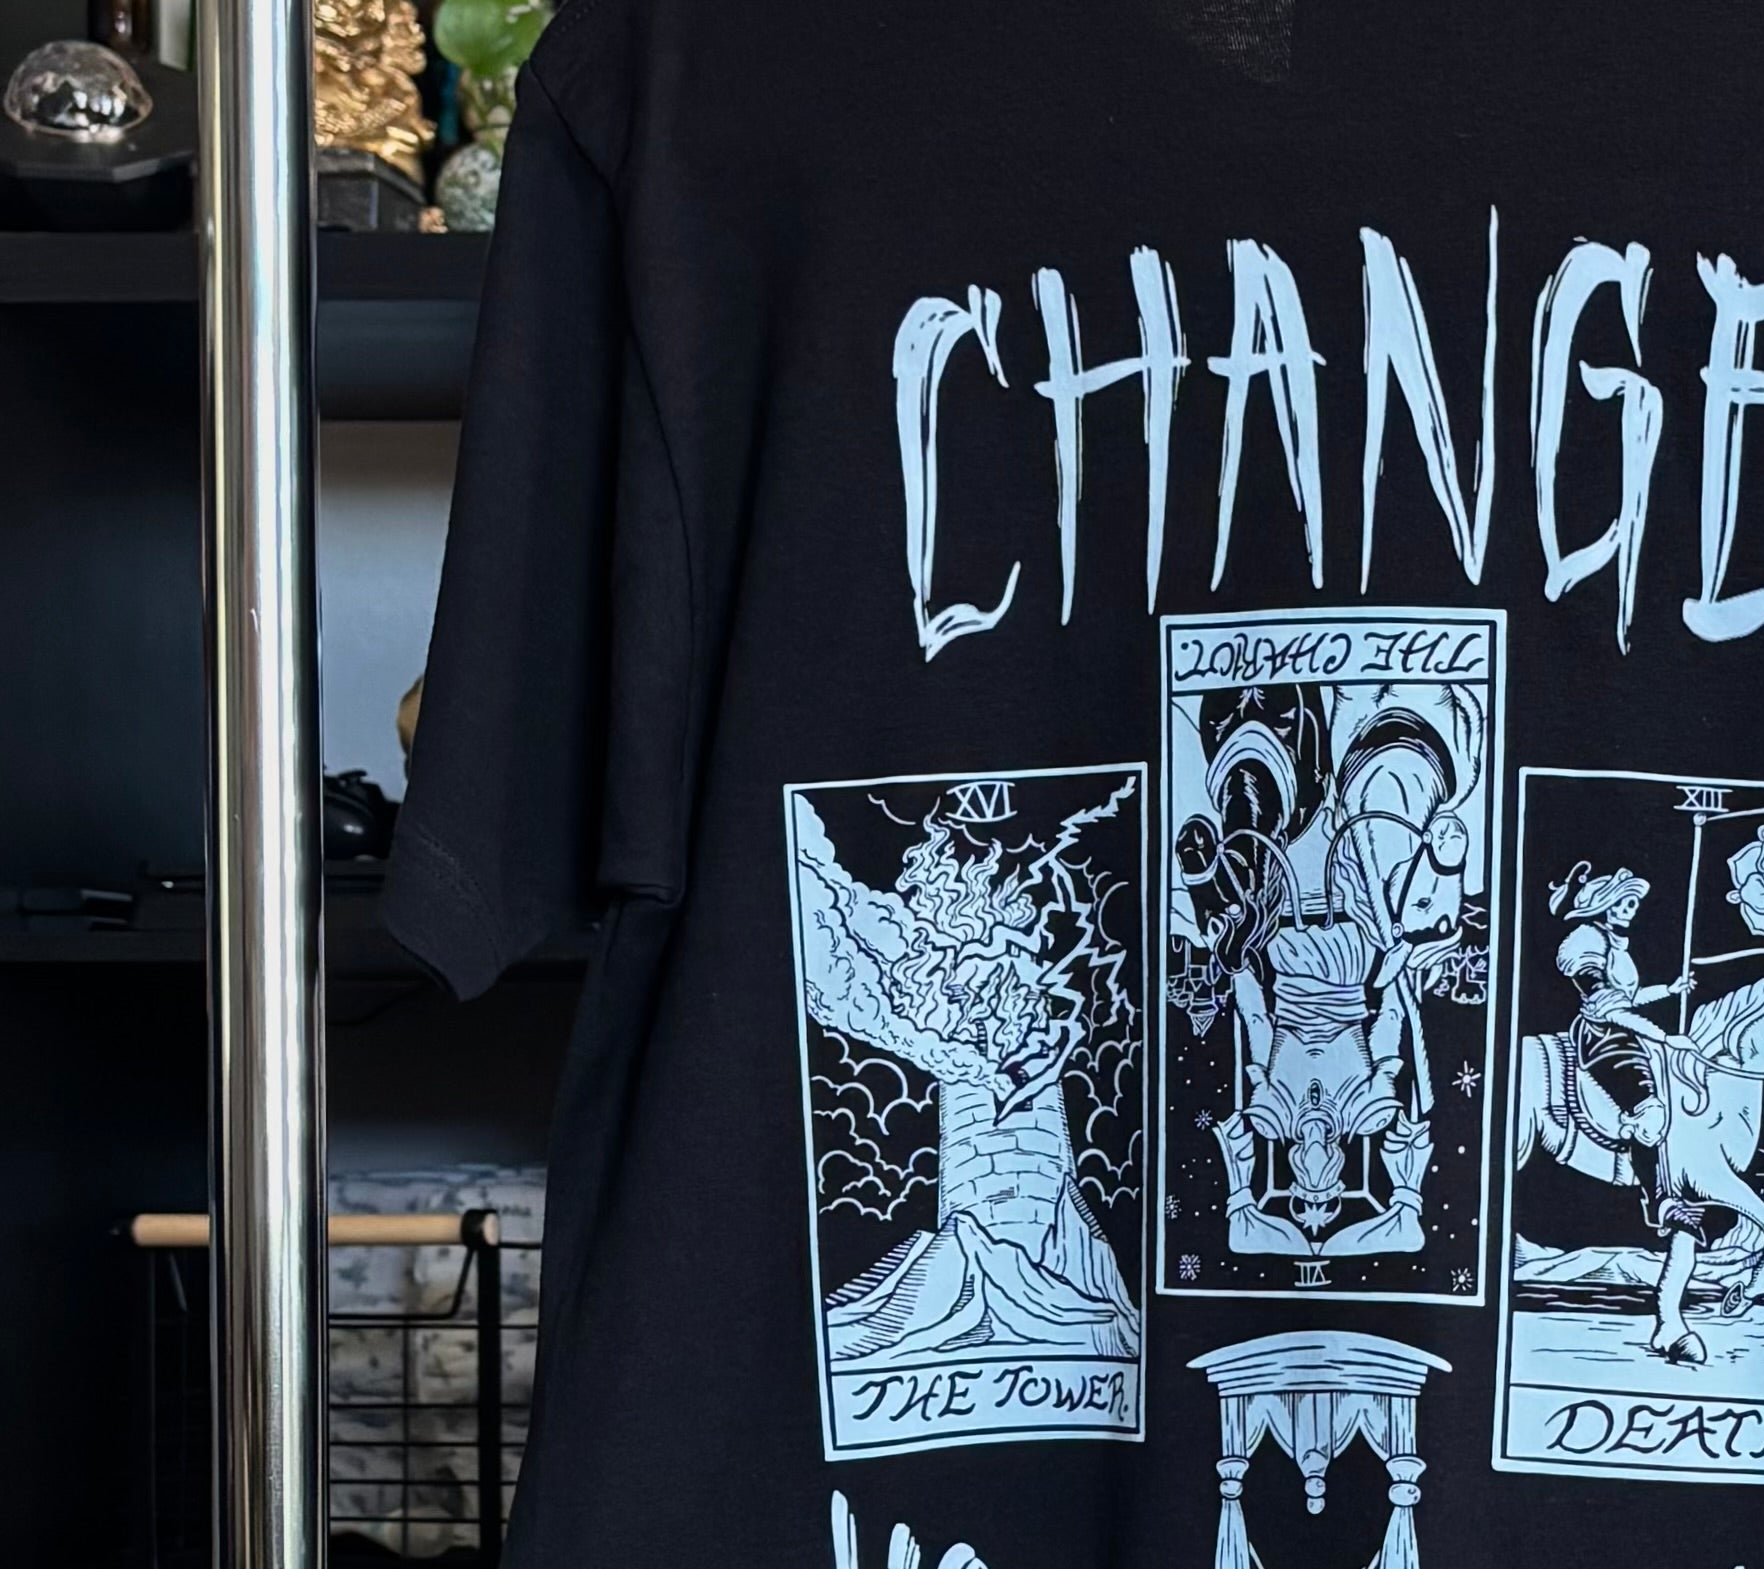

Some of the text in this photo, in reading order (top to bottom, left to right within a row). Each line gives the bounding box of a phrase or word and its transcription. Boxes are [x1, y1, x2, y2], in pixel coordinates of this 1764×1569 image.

[1360, 630, 1486, 674] THE
[945, 781, 1018, 823] XVI
[1673, 785, 1734, 813] XIII
[851, 1369, 983, 1422] THE
